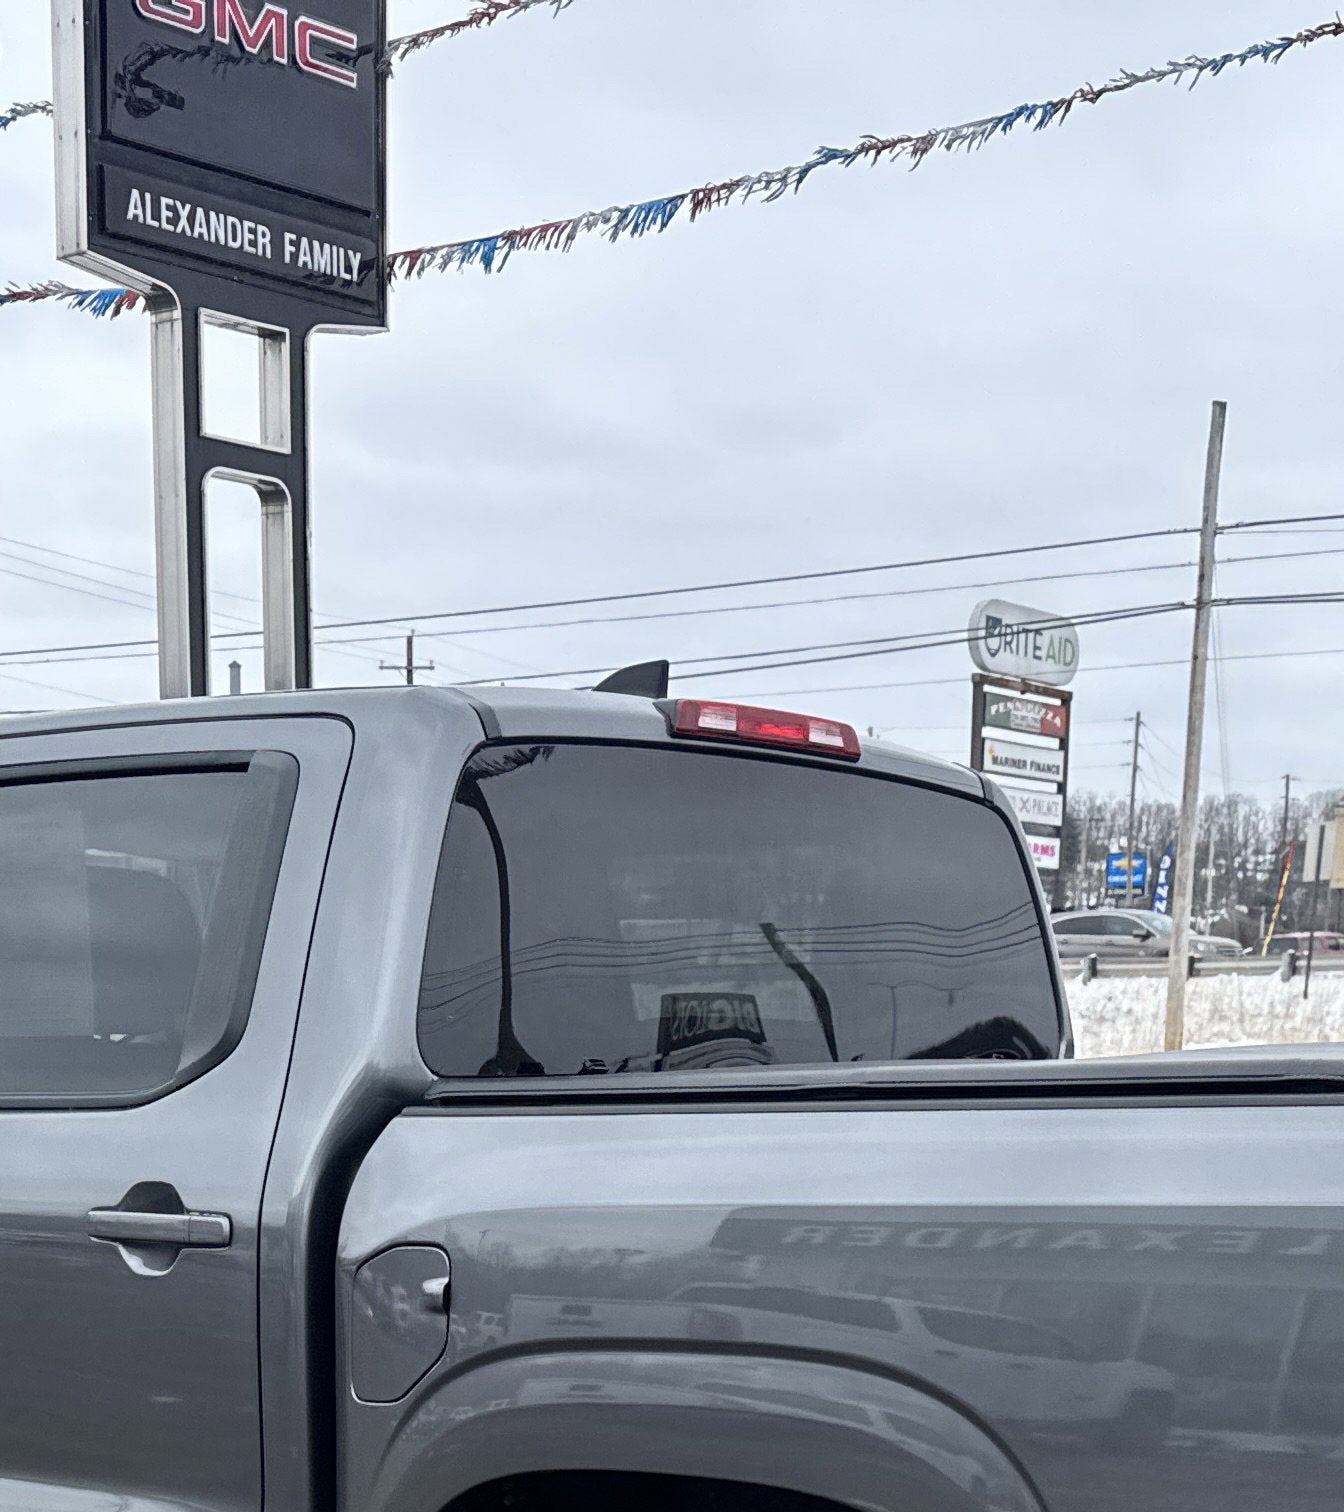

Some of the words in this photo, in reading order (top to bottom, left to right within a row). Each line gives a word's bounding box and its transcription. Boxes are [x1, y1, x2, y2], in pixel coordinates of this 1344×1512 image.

[127, 188, 272, 259] ALEXANDER
[283, 231, 362, 283] FAMILY
[1003, 623, 1043, 661] RITE
[1045, 634, 1076, 667] AID
[991, 755, 1027, 770] MARINER
[1029, 761, 1061, 776] FINANCE
